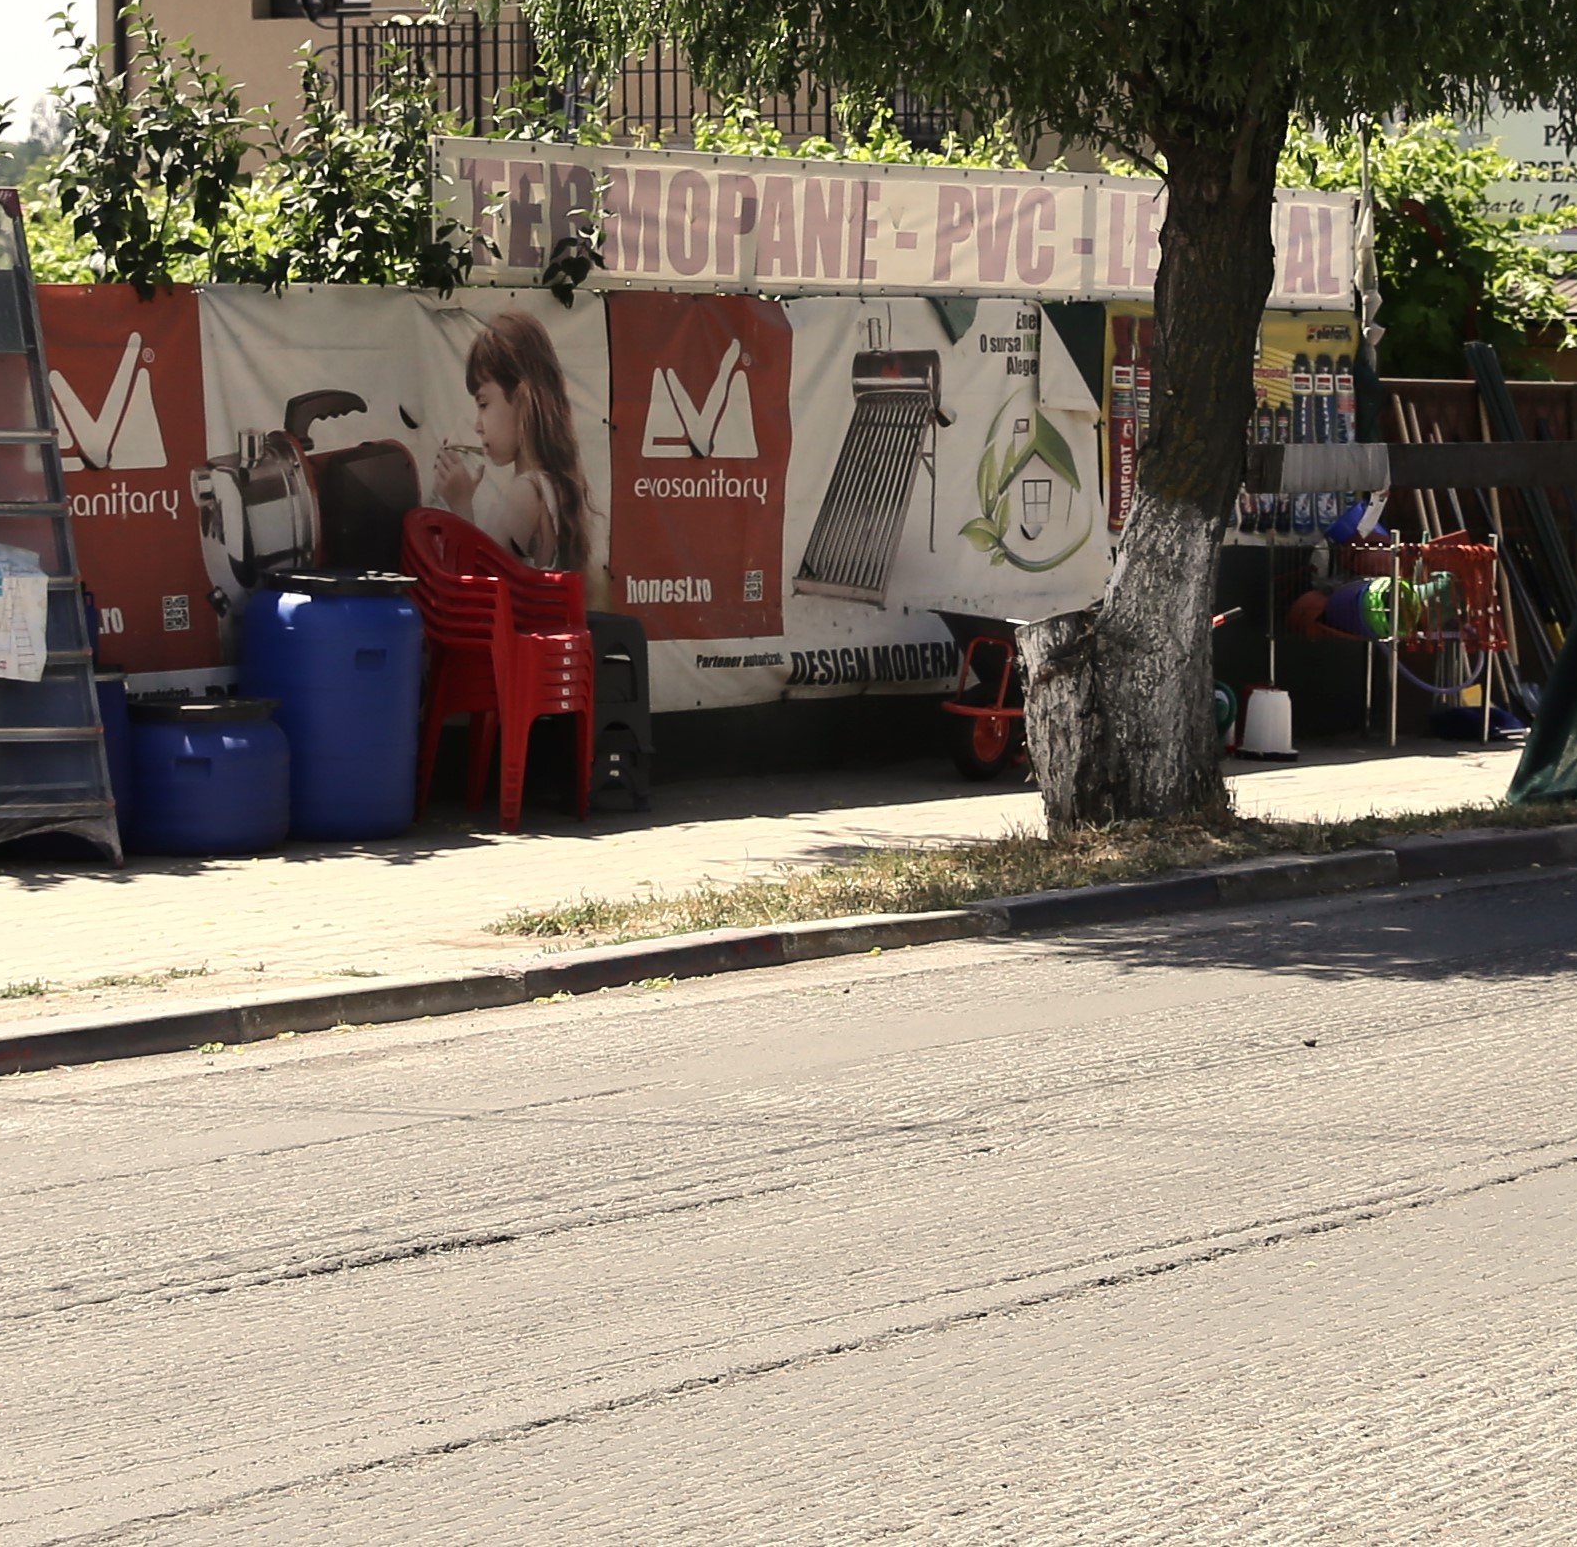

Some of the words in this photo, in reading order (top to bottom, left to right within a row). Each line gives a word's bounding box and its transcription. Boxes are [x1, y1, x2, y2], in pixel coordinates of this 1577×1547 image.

[459, 156, 880, 284] TERMOPANE
[934, 183, 1056, 286] PVC
[989, 336, 1021, 353] sursa
[633, 468, 768, 505] evosanitary
[1119, 444, 1133, 520] COMFORT
[625, 575, 712, 605] honest.ro
[696, 654, 742, 669] Partener
[786, 646, 870, 686] DESIGN
[872, 640, 961, 682] MODERN
